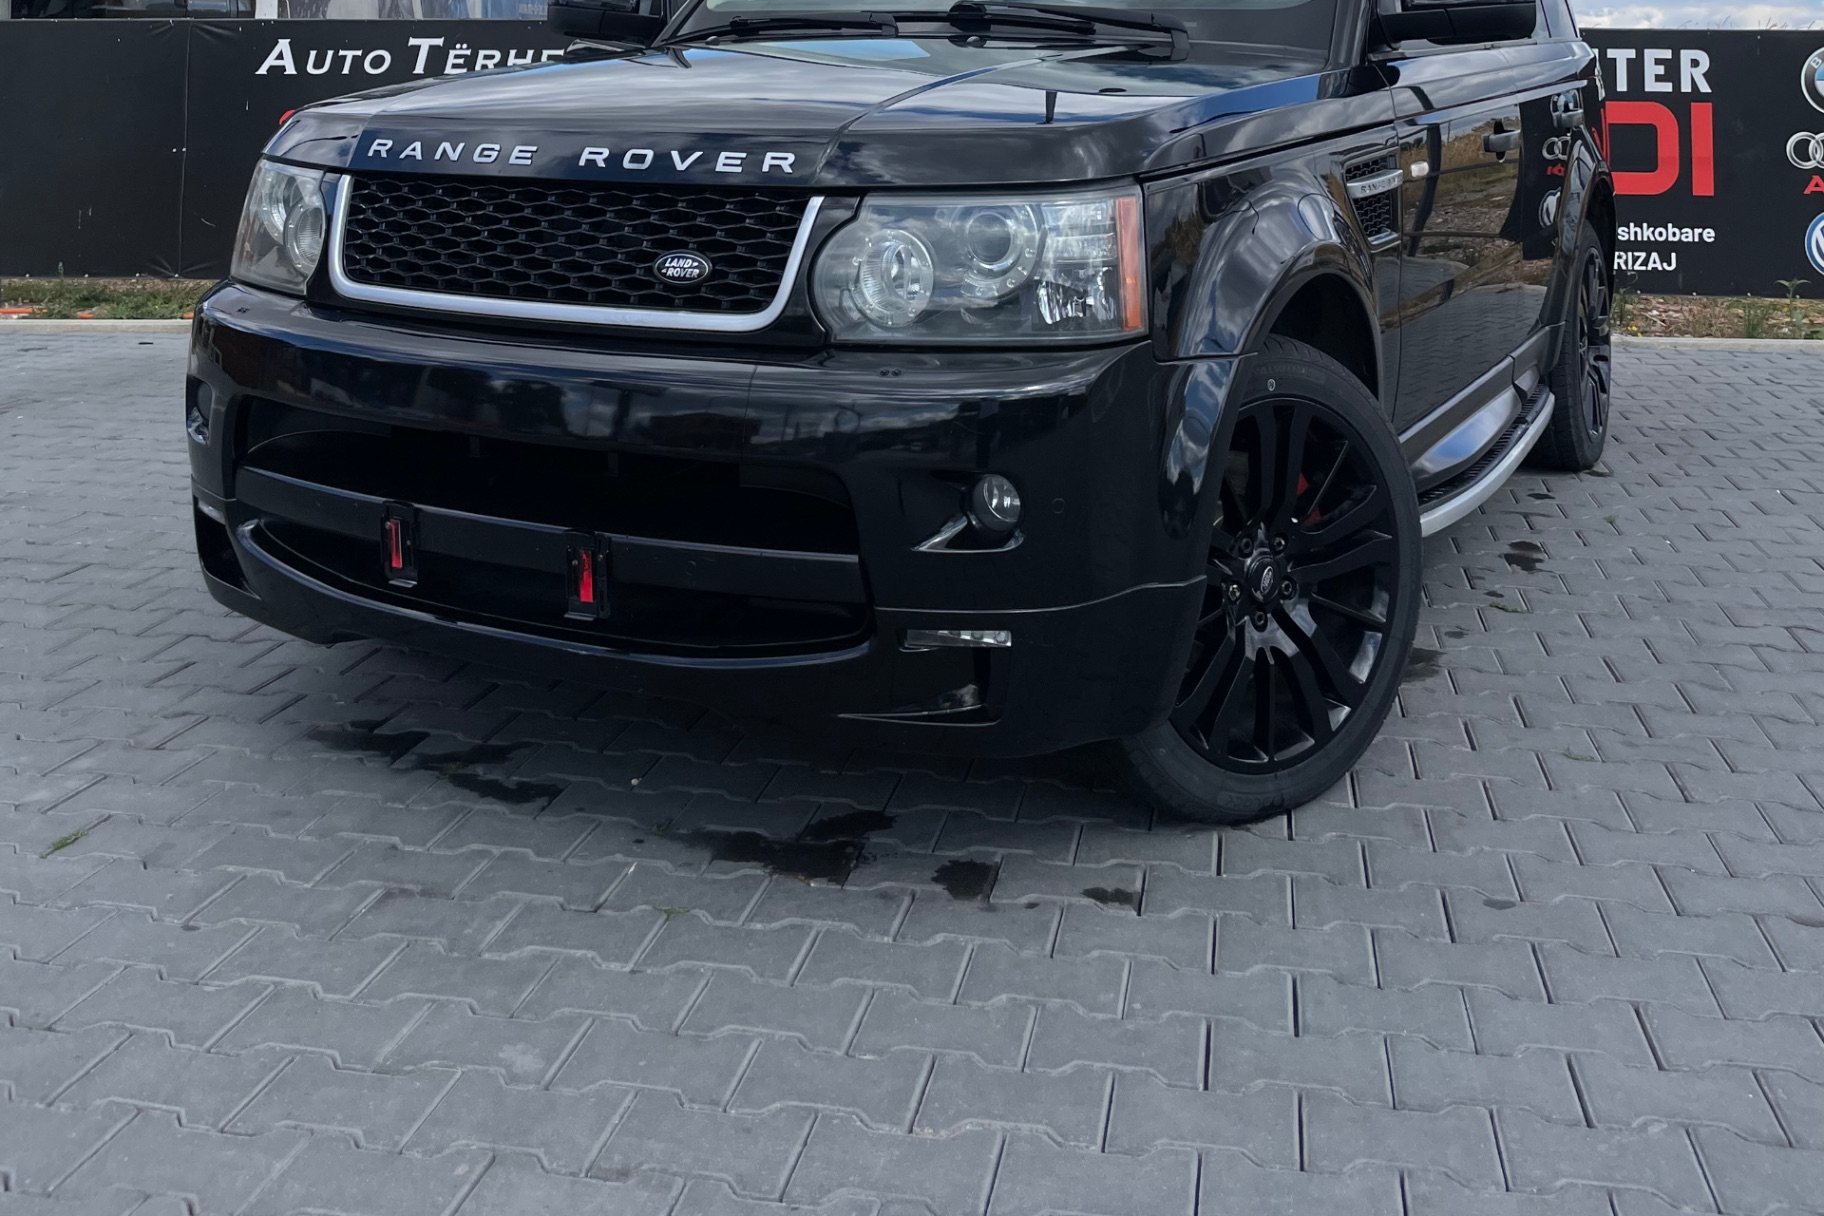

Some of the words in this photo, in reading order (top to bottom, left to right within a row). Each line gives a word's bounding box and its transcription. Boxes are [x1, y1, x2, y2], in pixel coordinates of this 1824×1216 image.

[1594, 48, 1712, 93] TER
[367, 138, 538, 166] RANGE
[578, 146, 797, 174] ROVER
[1617, 222, 1716, 243] shkobare
[665, 258, 693, 268] LAND
[666, 267, 700, 278] ROVER
